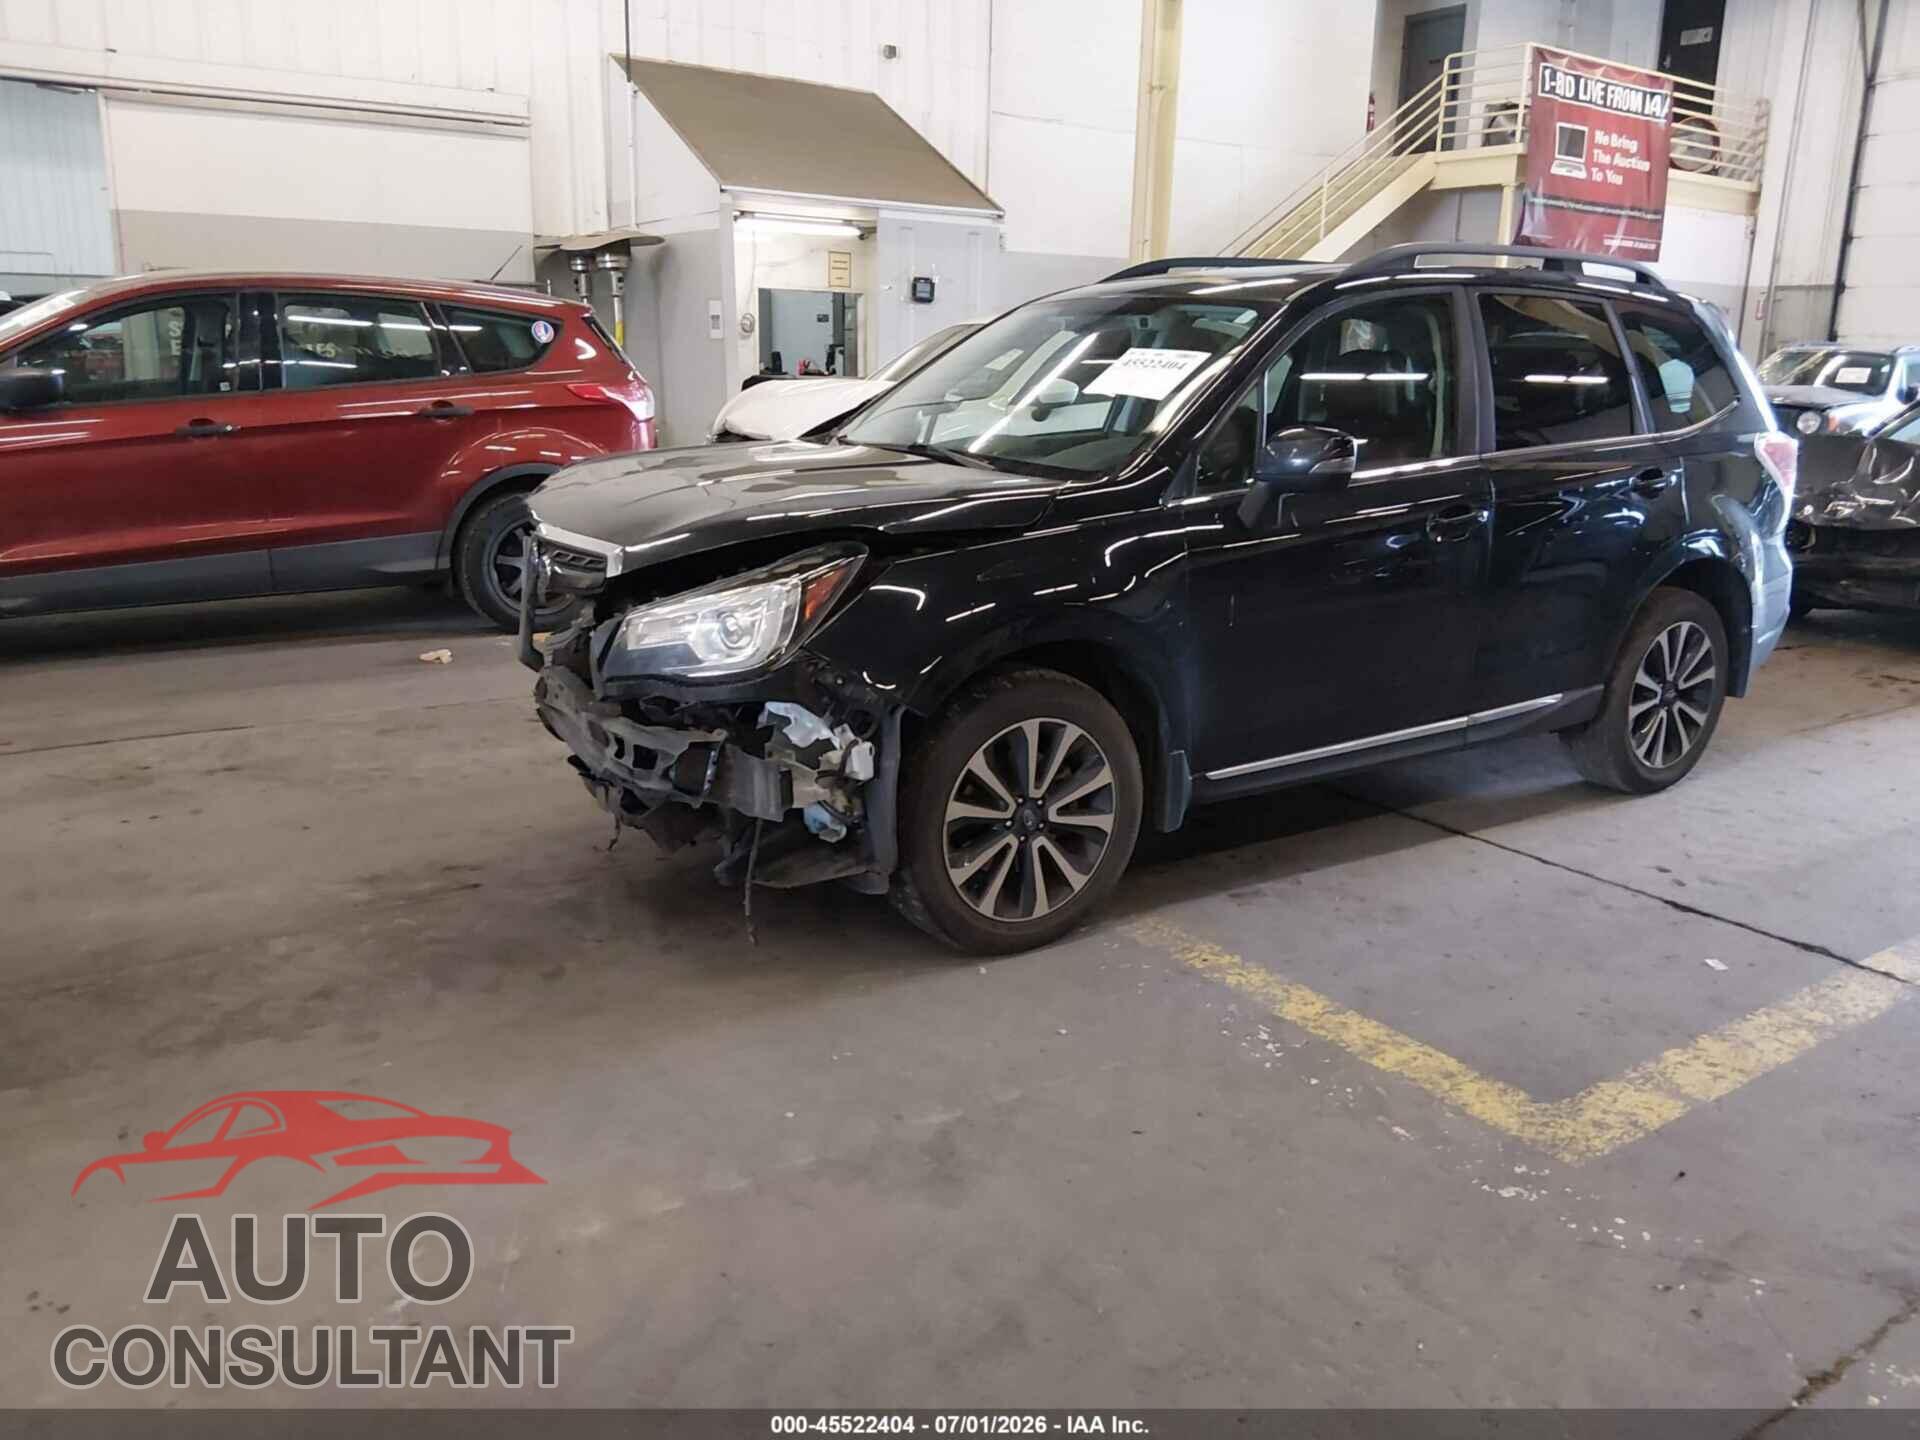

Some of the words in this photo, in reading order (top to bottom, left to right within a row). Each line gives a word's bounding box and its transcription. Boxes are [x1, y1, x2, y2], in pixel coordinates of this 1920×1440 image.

[1578, 77, 1606, 105] LIVE
[1606, 84, 1644, 114] FROM
[1610, 132, 1638, 154] Bring
[1592, 148, 1611, 165] The
[1612, 152, 1651, 172] Auction
[1590, 167, 1604, 182] To
[1605, 169, 1624, 185] You
